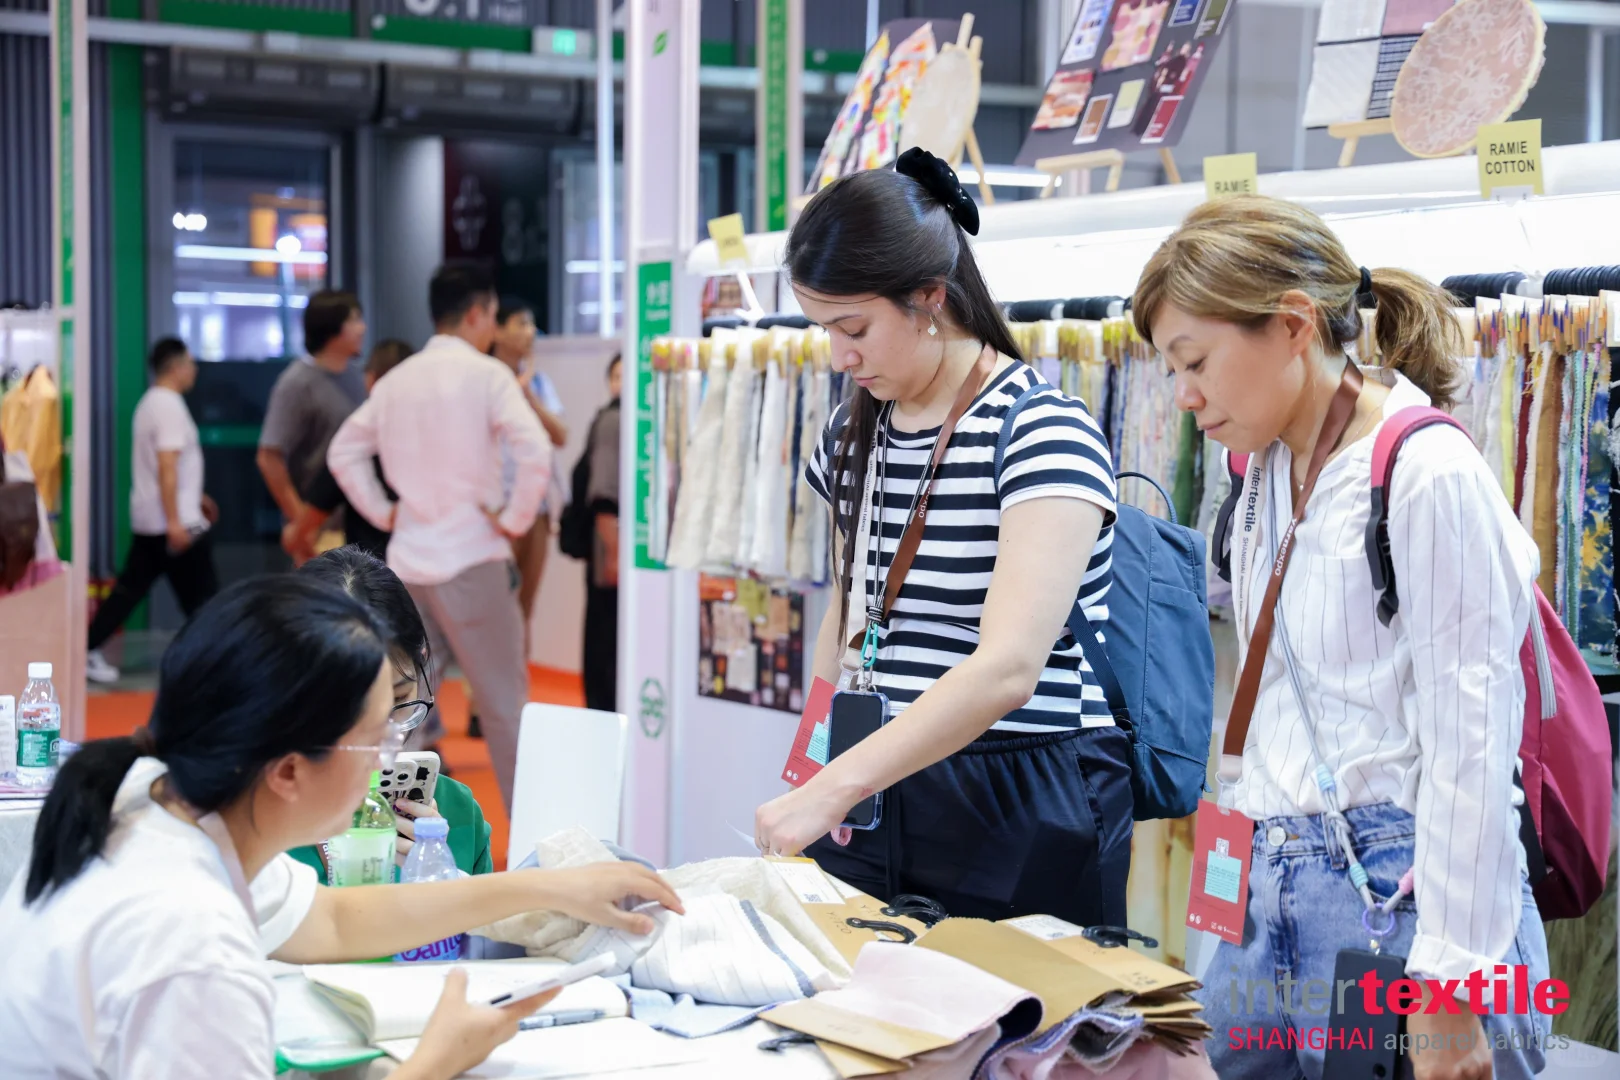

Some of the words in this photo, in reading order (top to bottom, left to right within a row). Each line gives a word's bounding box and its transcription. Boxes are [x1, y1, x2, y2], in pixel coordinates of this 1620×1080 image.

[1489, 140, 1528, 156] RAMIE
[1485, 159, 1535, 175] COTTON
[1214, 179, 1251, 195] RAMIE
[1244, 466, 1263, 533] intertextile
[1240, 537, 1248, 574] SHANGHAI
